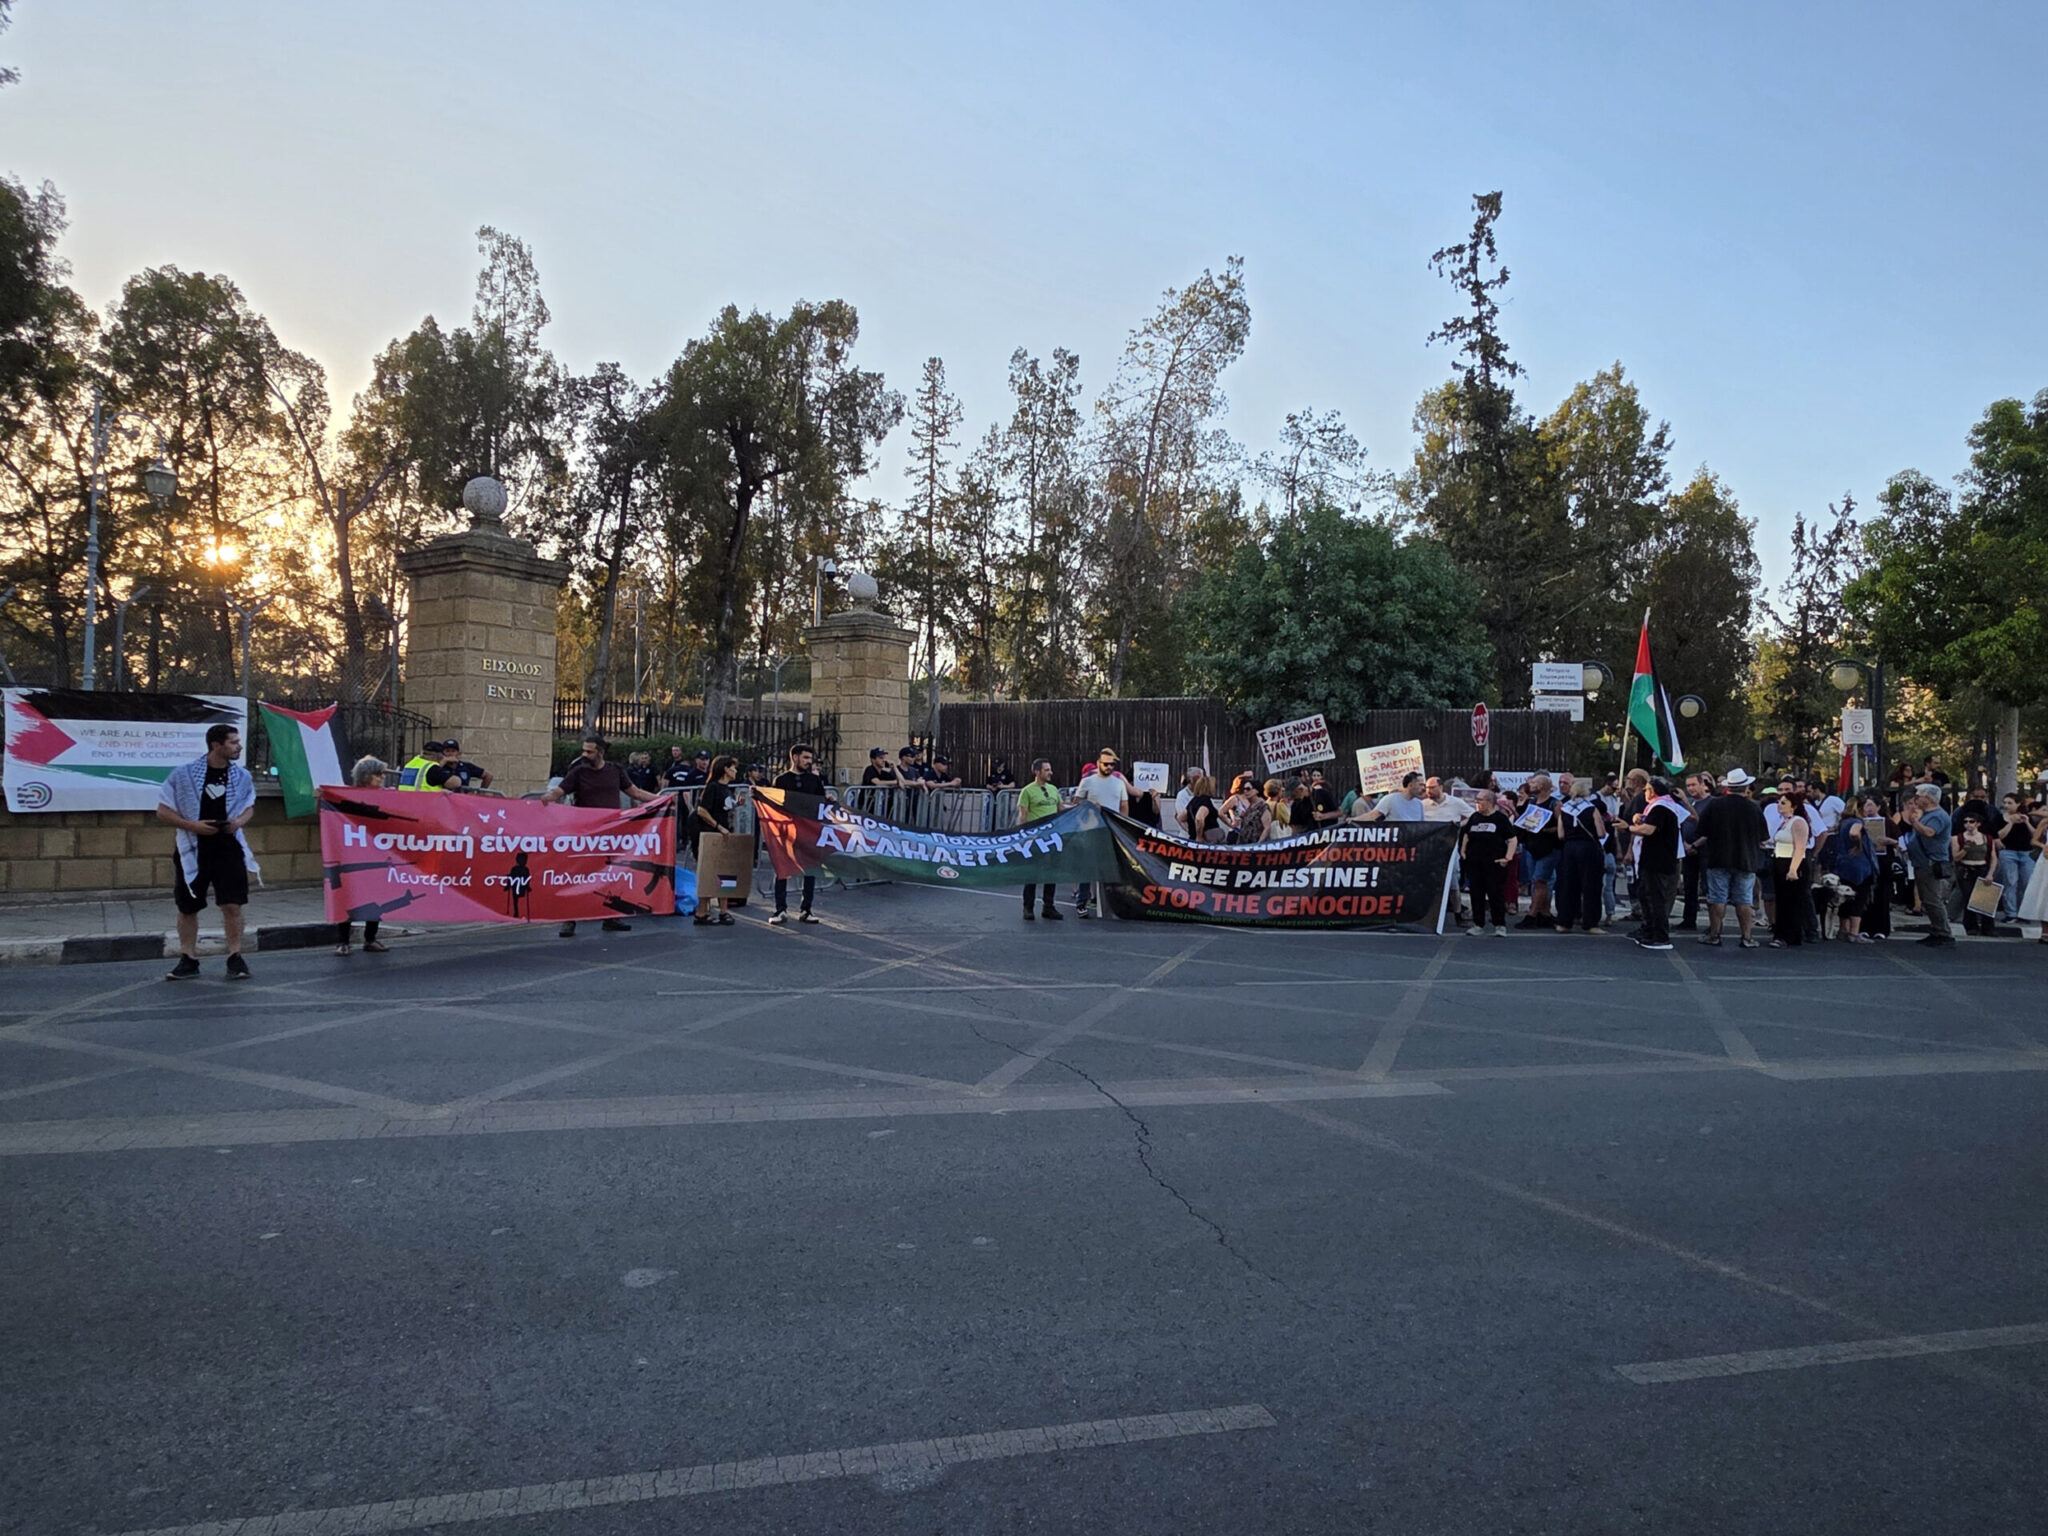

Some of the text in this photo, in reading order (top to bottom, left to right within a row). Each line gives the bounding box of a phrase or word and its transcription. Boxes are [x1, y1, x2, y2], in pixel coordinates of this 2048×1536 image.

[483, 658, 542, 676] ΕΙΣΟΔΟΣ
[488, 684, 536, 700] ENTRY
[80, 729, 96, 737] WE
[99, 729, 121, 738] ARE
[123, 730, 141, 738] ALL
[1472, 713, 1488, 736] STOP
[92, 750, 113, 758] END
[117, 751, 137, 759] THE
[1370, 745, 1414, 761] STAND UP
[1380, 756, 1421, 770] PALESTINE
[1138, 773, 1160, 781] GAZA
[343, 824, 661, 859] Η σιωπή είναι συνενοχή
[815, 826, 1064, 867] ΑΛΛΗΛΕΓΓΥΗ
[1136, 838, 1250, 865] ΣΤΑΜΑΤΗΣΤΕ
[1256, 851, 1292, 866] ΤΗΝ
[387, 866, 633, 894] Λευτεριά στην Παλαιστίνη
[1168, 861, 1379, 888] FREE PALESTINE!
[1141, 885, 1404, 916] STOP THE GENOCIDE!
